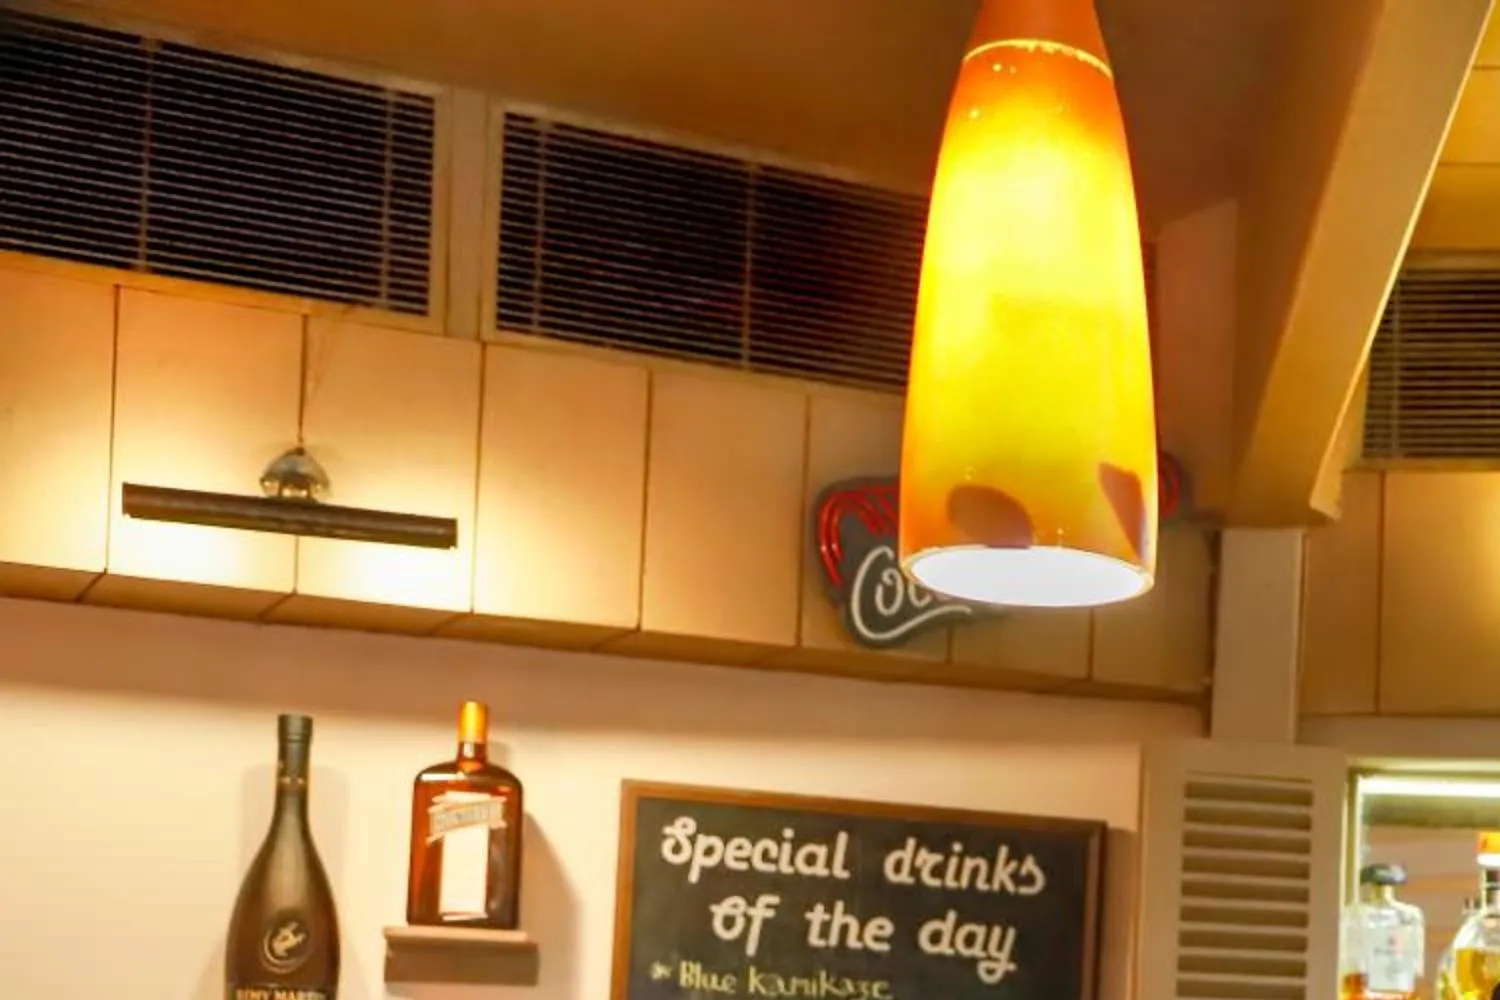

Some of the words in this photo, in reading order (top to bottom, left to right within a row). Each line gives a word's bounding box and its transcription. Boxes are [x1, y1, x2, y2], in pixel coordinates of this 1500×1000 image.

[661, 816, 852, 883] Special
[883, 837, 1046, 897] drinks
[679, 960, 736, 994] Blue
[805, 900, 895, 953] the
[918, 910, 1017, 984] day
